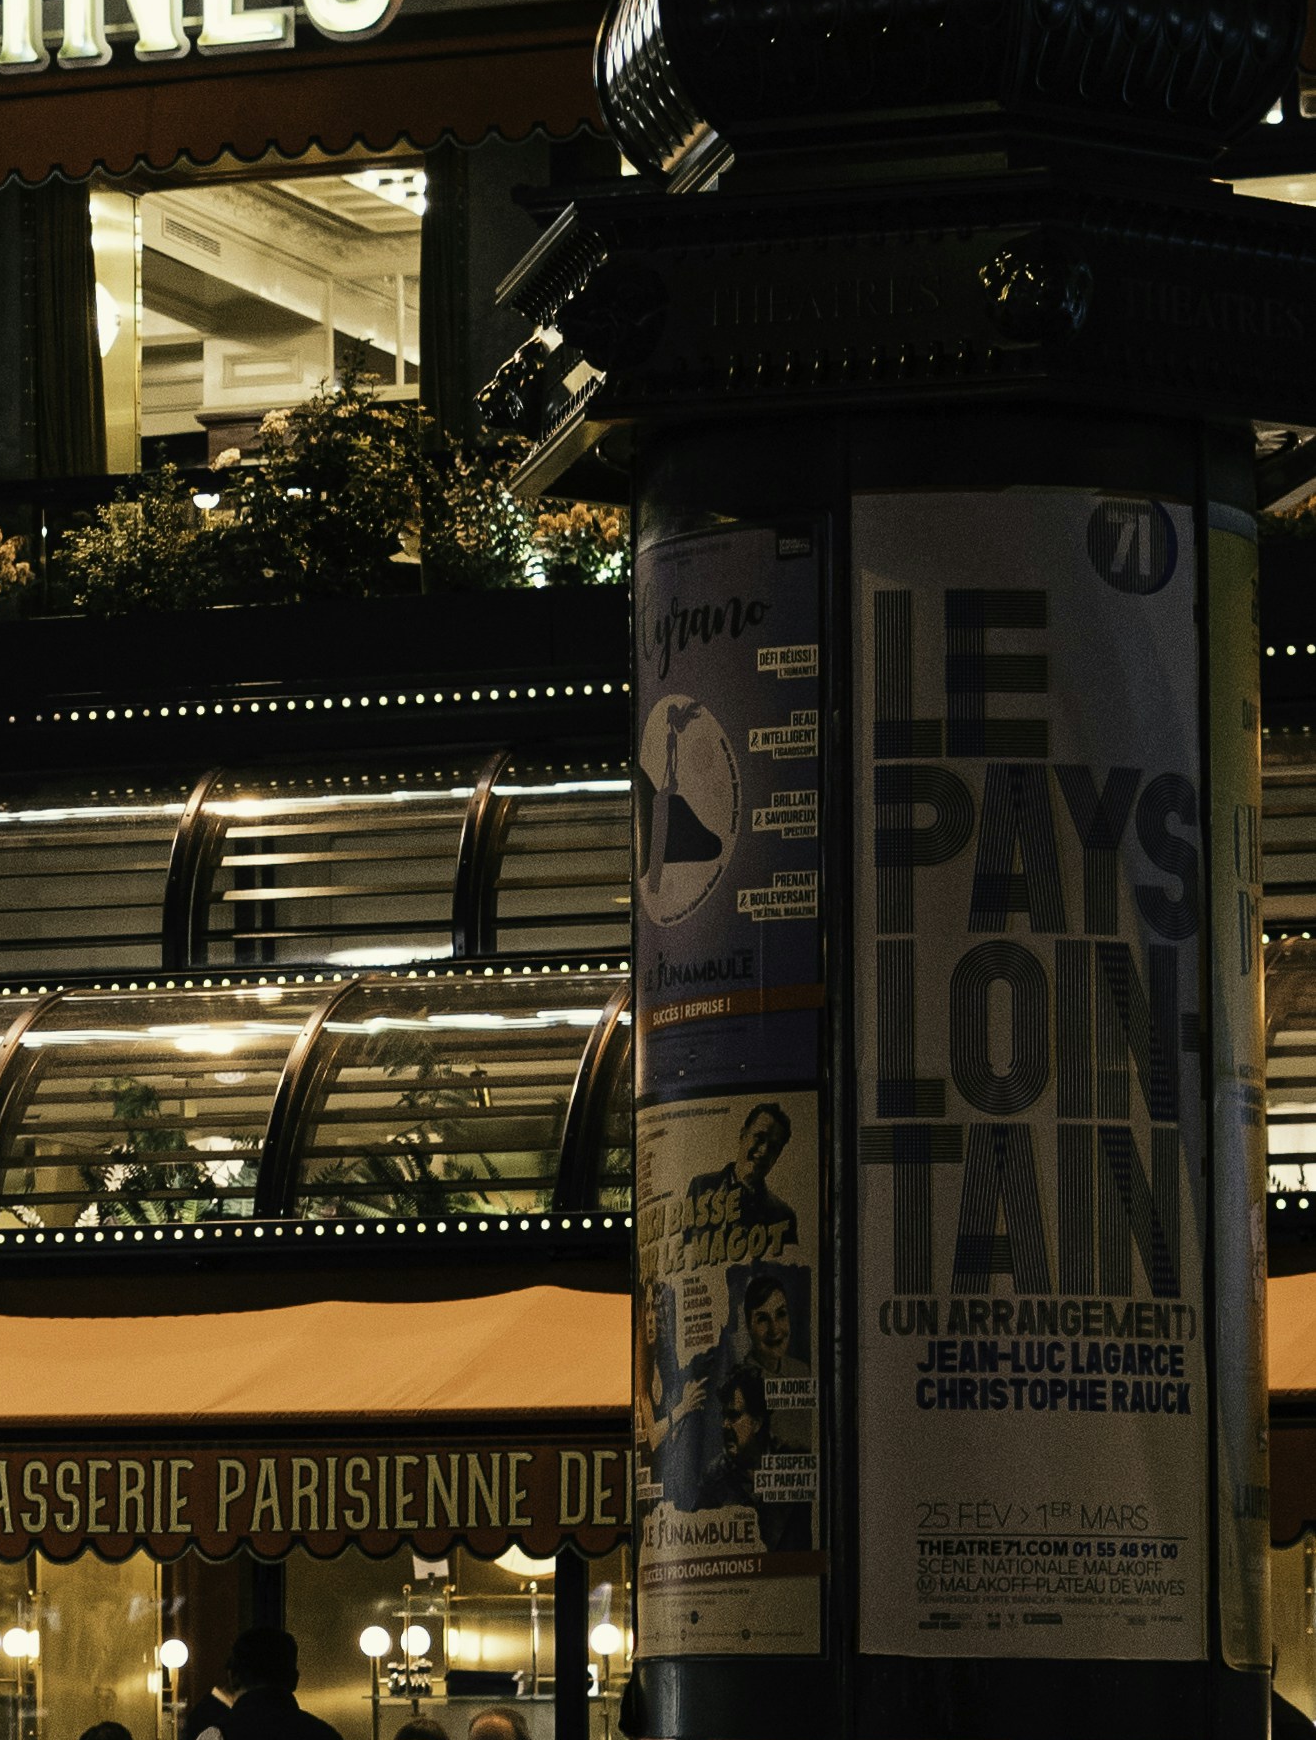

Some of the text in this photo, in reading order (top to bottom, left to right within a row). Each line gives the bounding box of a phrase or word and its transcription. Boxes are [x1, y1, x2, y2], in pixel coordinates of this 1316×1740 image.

[780, 647, 812, 664] RÉUSSI
[873, 588, 1049, 759] LE
[792, 712, 817, 726] BEAU
[761, 728, 817, 745] INTELLIGENT
[773, 791, 817, 807] BRILLANT
[764, 809, 817, 825] SAVOUREUX
[873, 762, 1199, 941] PAYS
[774, 871, 817, 887] PRENANT
[749, 889, 816, 906] BOULEVERSANT
[684, 998, 725, 1018] REPRISE
[669, 1185, 743, 1236] BASSE
[859, 1122, 1181, 1298] TAIN
[690, 1220, 791, 1272] MAGOT
[879, 1299, 1197, 1341] (UN ARRANGEMENT)
[916, 1340, 1185, 1378] JEAN-LUC LAGARCE
[766, 1382, 778, 1394] ON
[780, 1380, 811, 1394] ADORE
[916, 1377, 1191, 1415] CHRISTOPHE RAUCK
[763, 1456, 817, 1470] LE SUSPENS
[756, 1474, 773, 1488] EST
[774, 1472, 812, 1488] PARFAIT
[217, 1451, 535, 1534] PARISIENNE
[918, 1503, 950, 1529] 25
[958, 1499, 1013, 1529] FÉV
[1080, 1504, 1149, 1532] MARS
[917, 1540, 1178, 1559] THEATRE71.COM 01 55 48 91 00
[668, 1559, 755, 1580] PROLONGATIONS
[918, 1557, 1163, 1576] SCÈNE NATIONALE MALAKOFF
[1110, 1578, 1132, 1594] DE
[1133, 1579, 1186, 1596] VANVES
